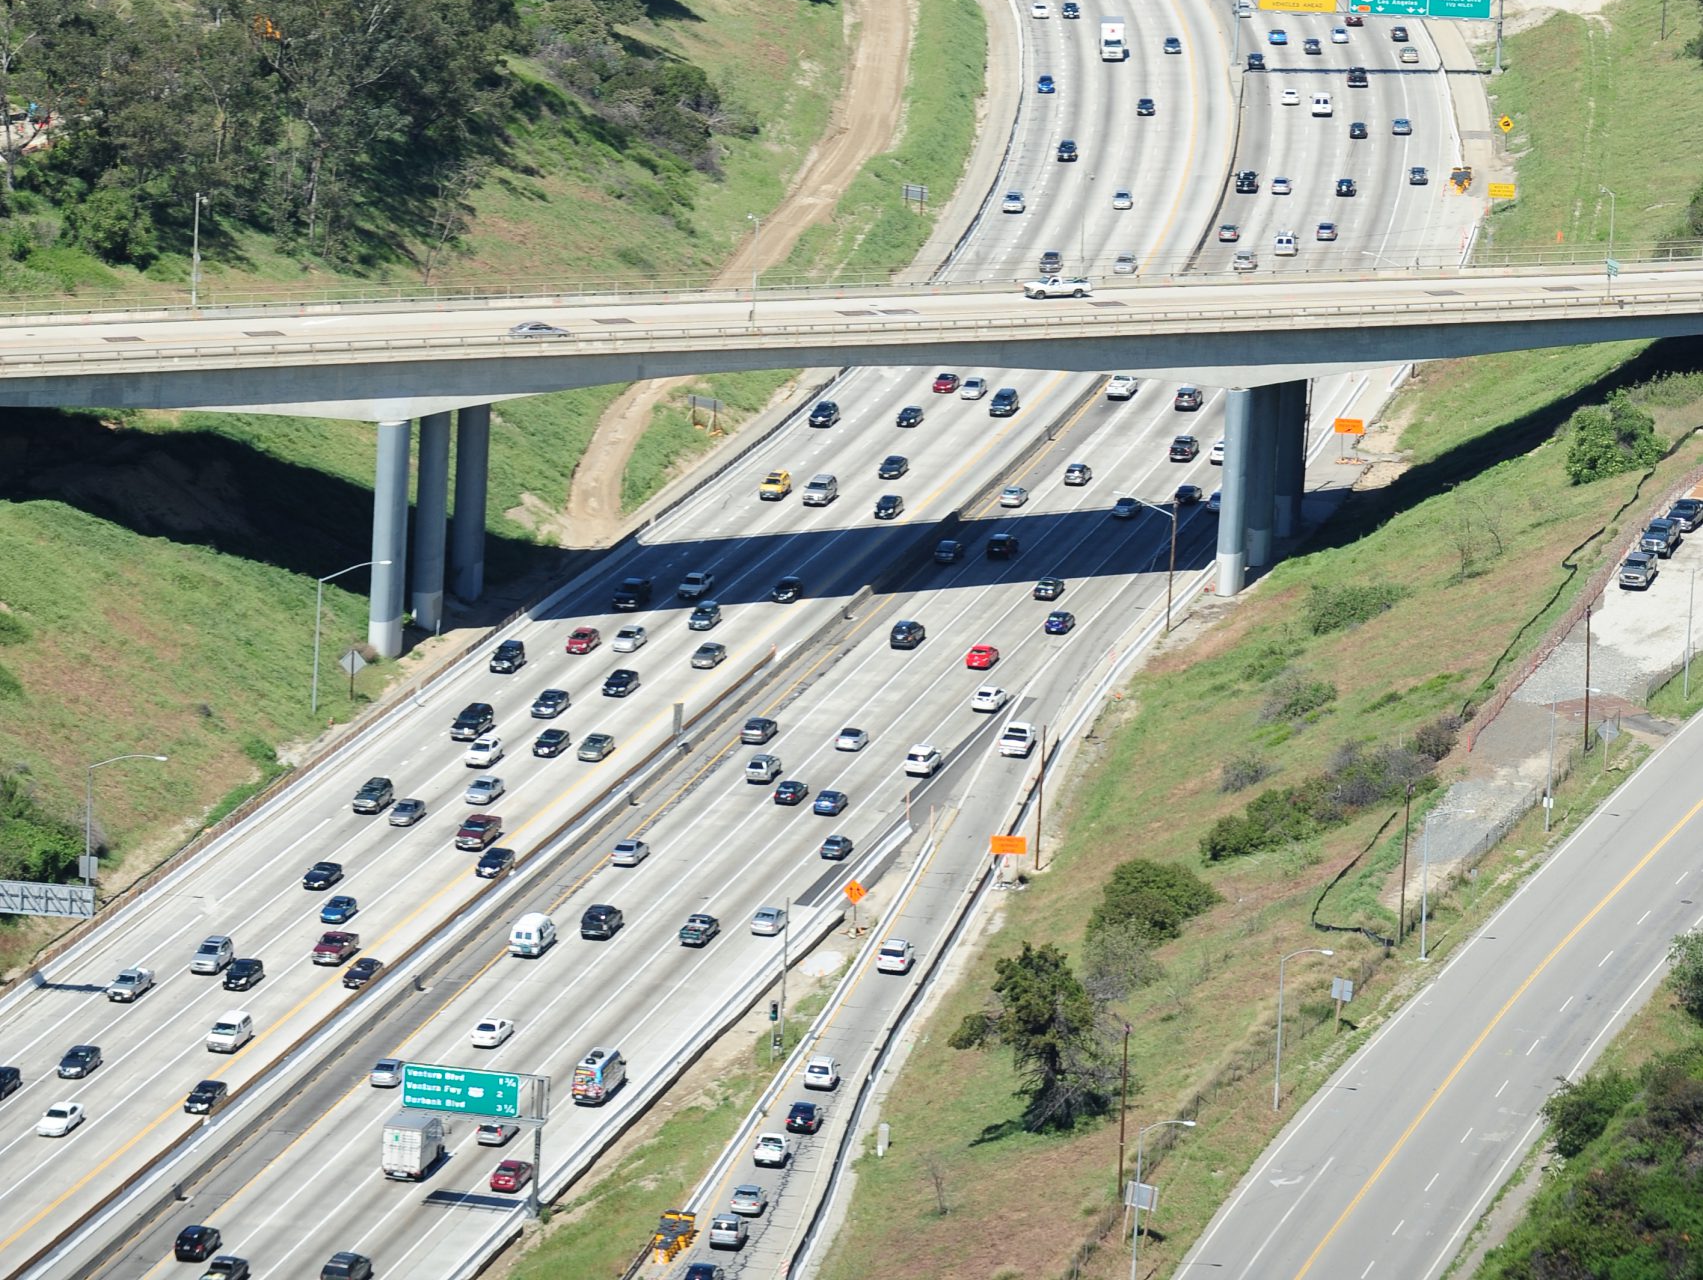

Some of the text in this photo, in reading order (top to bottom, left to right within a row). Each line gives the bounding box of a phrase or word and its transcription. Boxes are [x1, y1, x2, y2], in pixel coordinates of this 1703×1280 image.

[407, 1069, 443, 1079] Ventura
[444, 1072, 465, 1082] Blvd
[406, 1081, 442, 1092] Ventura
[444, 1085, 462, 1095] Fwy
[496, 1090, 504, 1098] 2
[405, 1095, 442, 1106] Burbank
[445, 1099, 466, 1108] Blvd
[496, 1104, 503, 1112] 3
